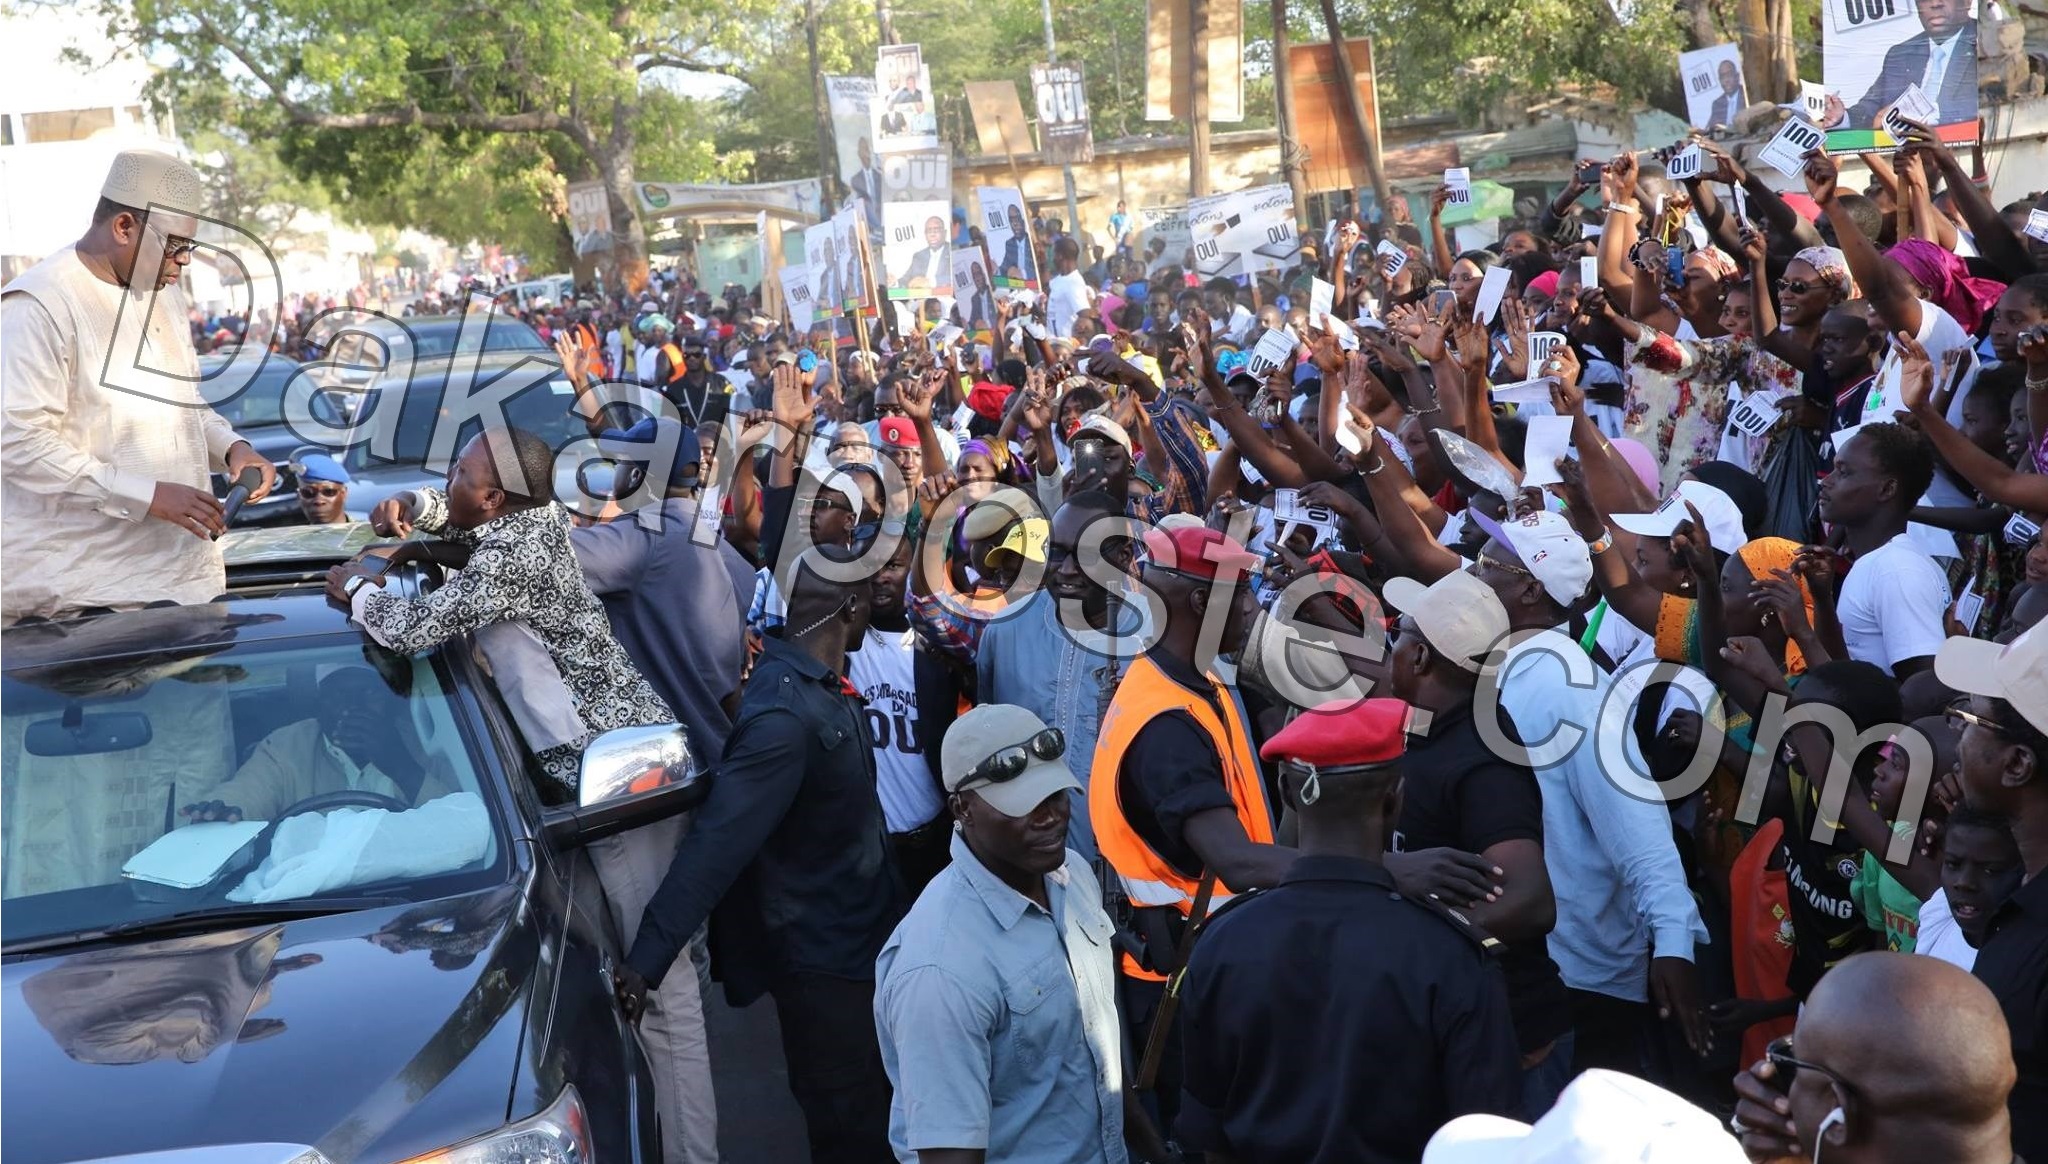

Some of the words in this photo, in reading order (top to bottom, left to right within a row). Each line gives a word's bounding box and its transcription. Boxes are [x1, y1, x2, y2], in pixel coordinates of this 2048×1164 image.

[1691, 72, 1711, 93] OUI
[1783, 122, 1820, 150] OUI
[1672, 154, 1697, 175] OUI
[1450, 189, 1469, 203] OUI
[988, 211, 1004, 228] OUI
[894, 224, 915, 243] OUI
[1267, 223, 1291, 245] OUI
[1196, 239, 1220, 261] OUI
[954, 270, 969, 288] OUI
[791, 282, 811, 302] OUI
[1735, 406, 1767, 434] OUI
